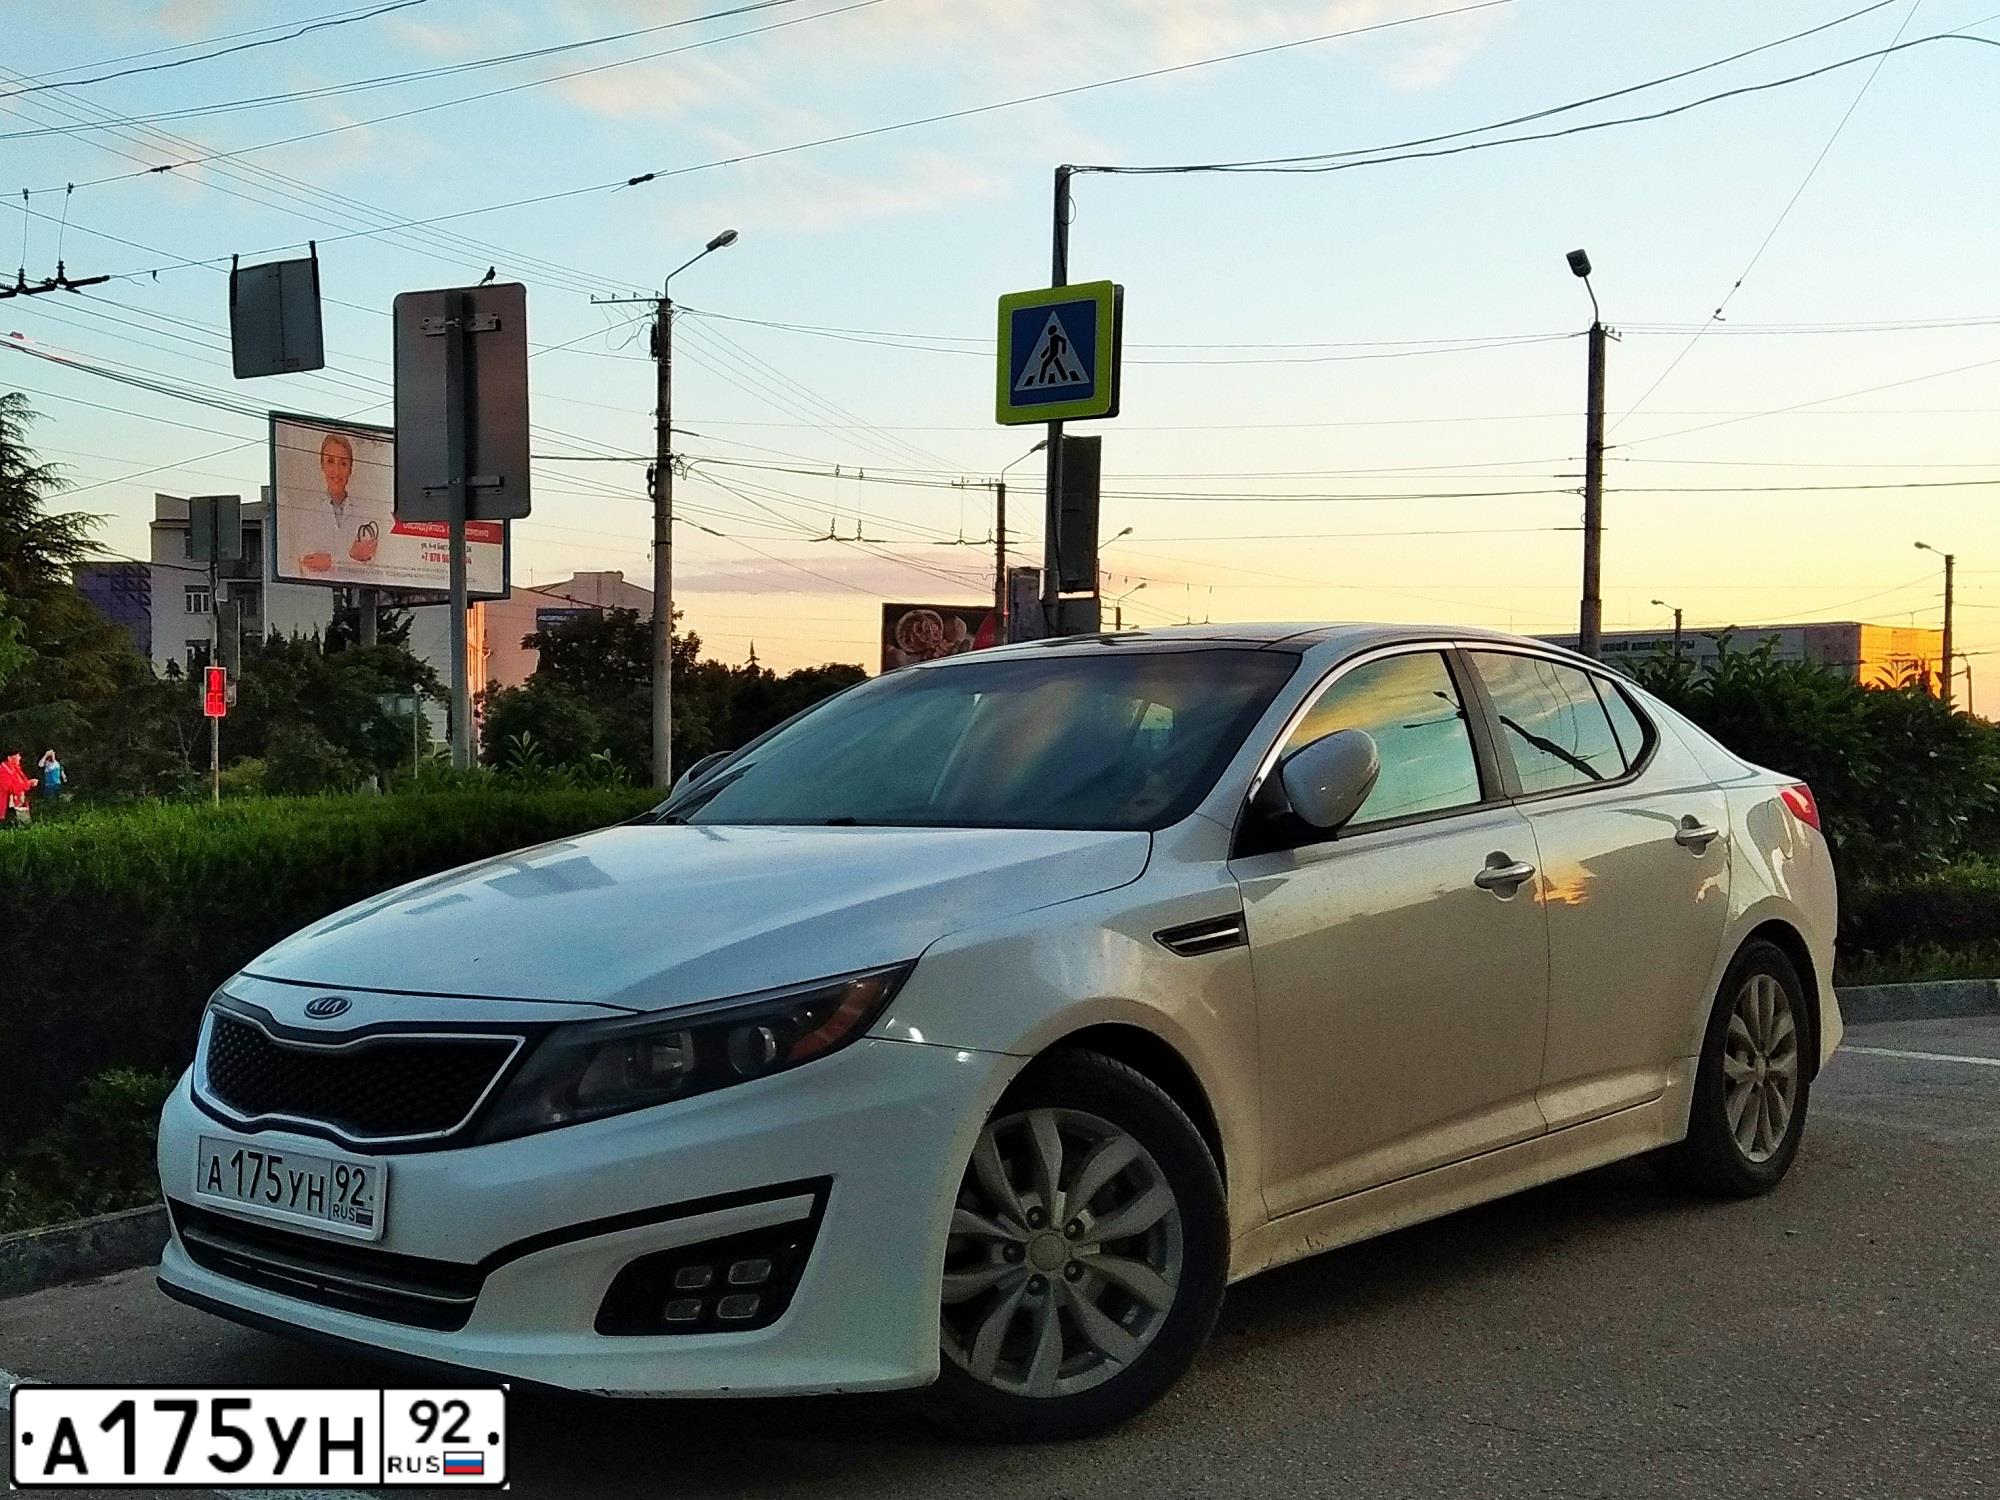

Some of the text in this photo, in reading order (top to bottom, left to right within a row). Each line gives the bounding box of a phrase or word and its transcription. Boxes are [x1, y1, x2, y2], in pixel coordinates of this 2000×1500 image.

[207, 1149, 367, 1213] А175УН 92
[332, 1204, 356, 1221] RUS
